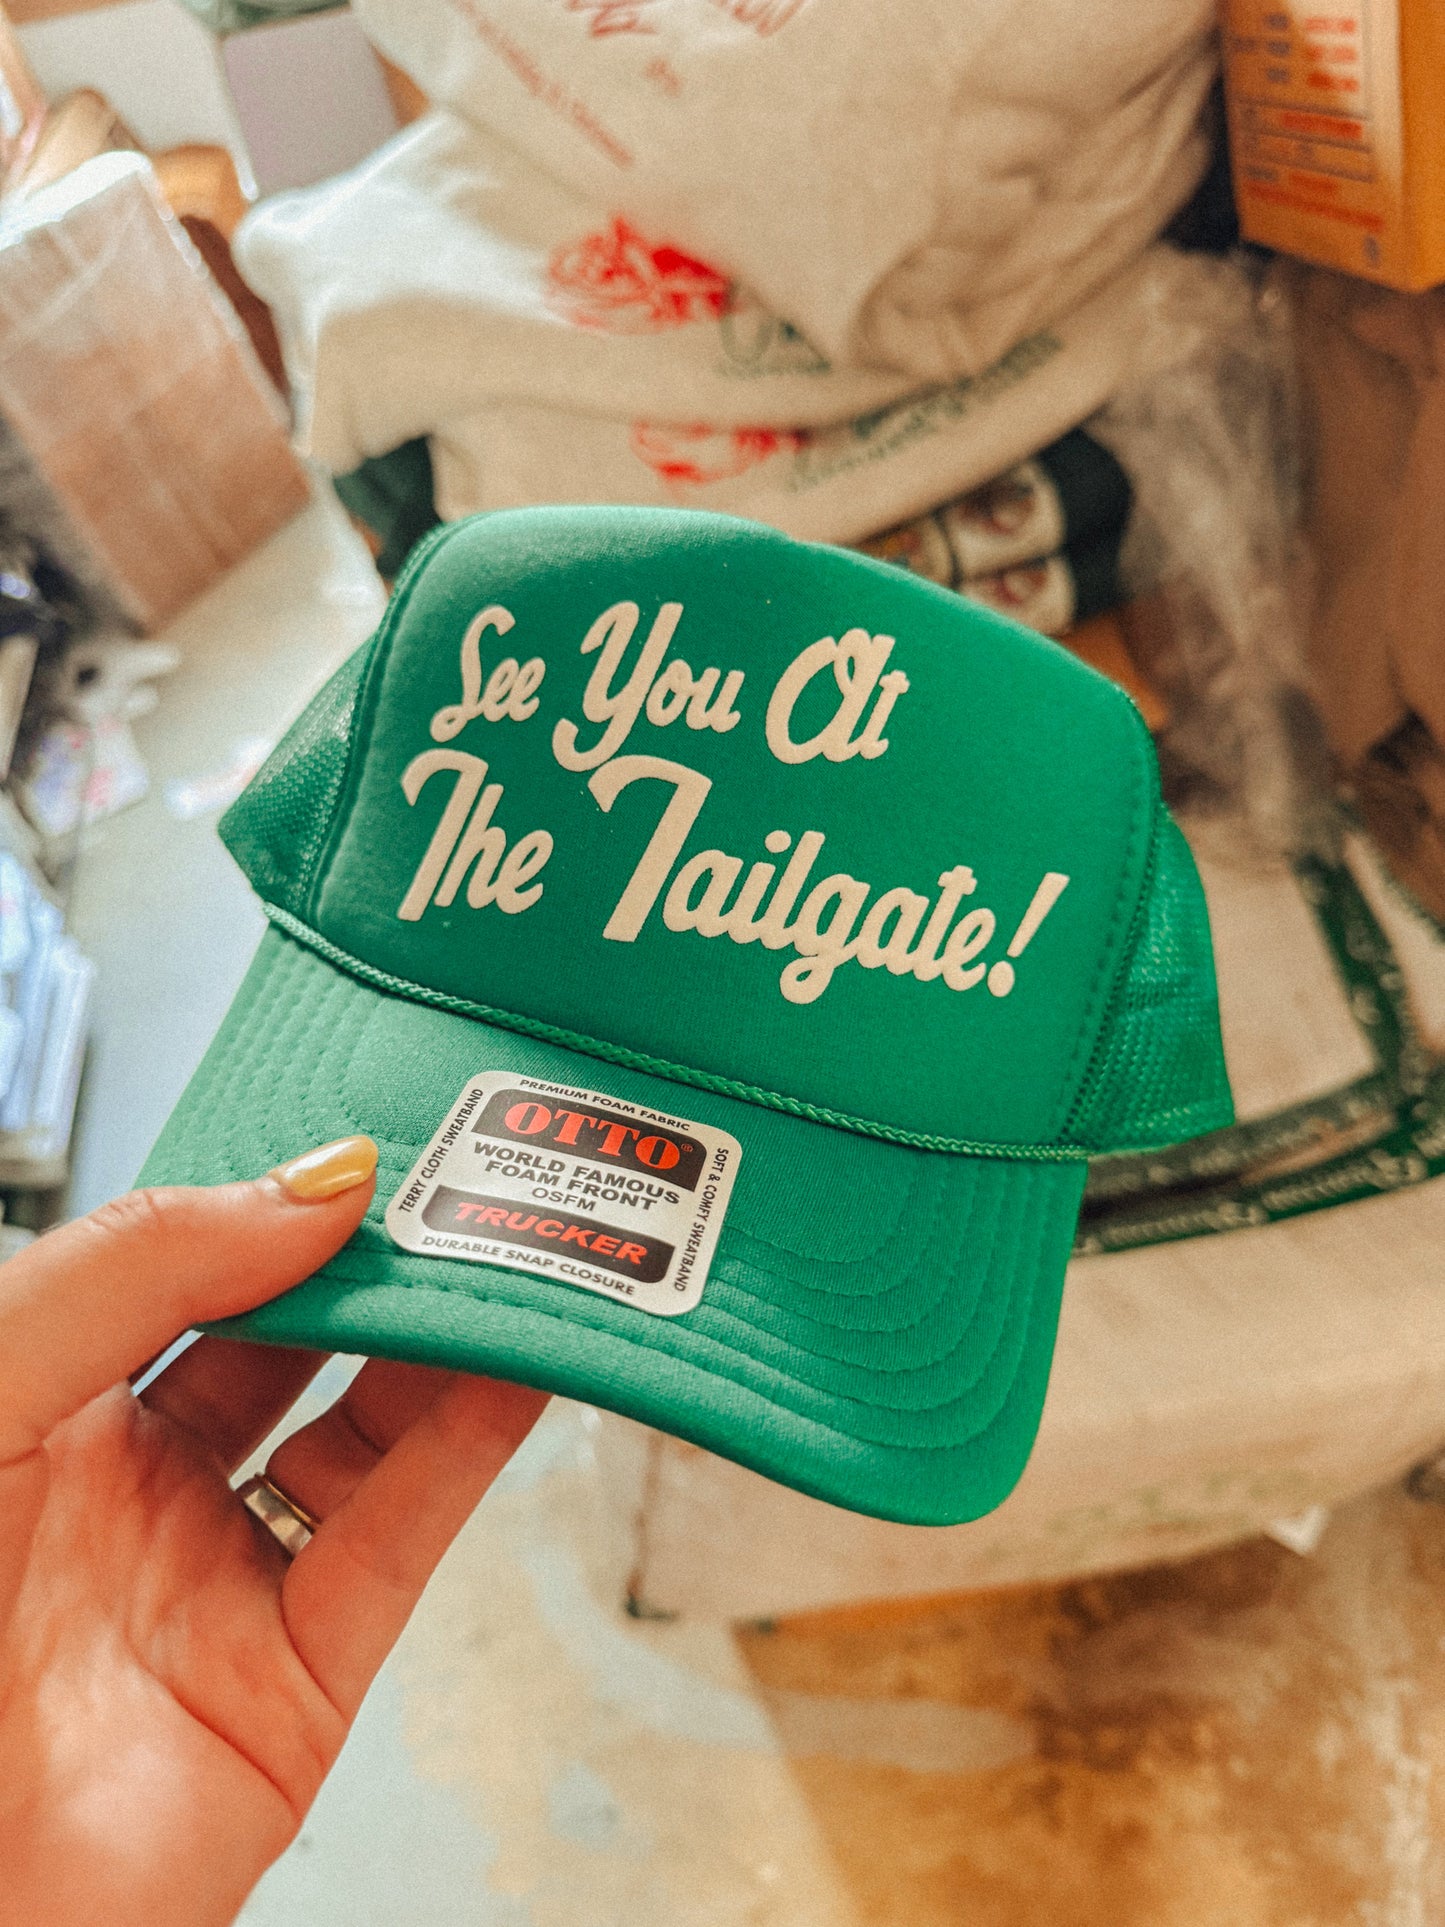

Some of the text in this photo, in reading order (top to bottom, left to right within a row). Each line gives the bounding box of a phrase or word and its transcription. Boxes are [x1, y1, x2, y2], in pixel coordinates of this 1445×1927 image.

[430, 601, 910, 772] See You At
[397, 748, 1070, 1004] The Tailgate!
[520, 1079, 691, 1131] PREMIUM FOAM FABRIC
[398, 1088, 484, 1213] TERRY CLOTH SWEATBAND
[473, 1141, 680, 1205] WORLD FAMOUS
[485, 1160, 658, 1211] FOAM FRONT
[531, 1187, 596, 1212] OSFM
[453, 1202, 648, 1265] TRUCKER
[673, 1147, 730, 1292] SOFT & COMFY SWEATBAND
[421, 1235, 635, 1296] DURABLE SNAP CLOSURE
